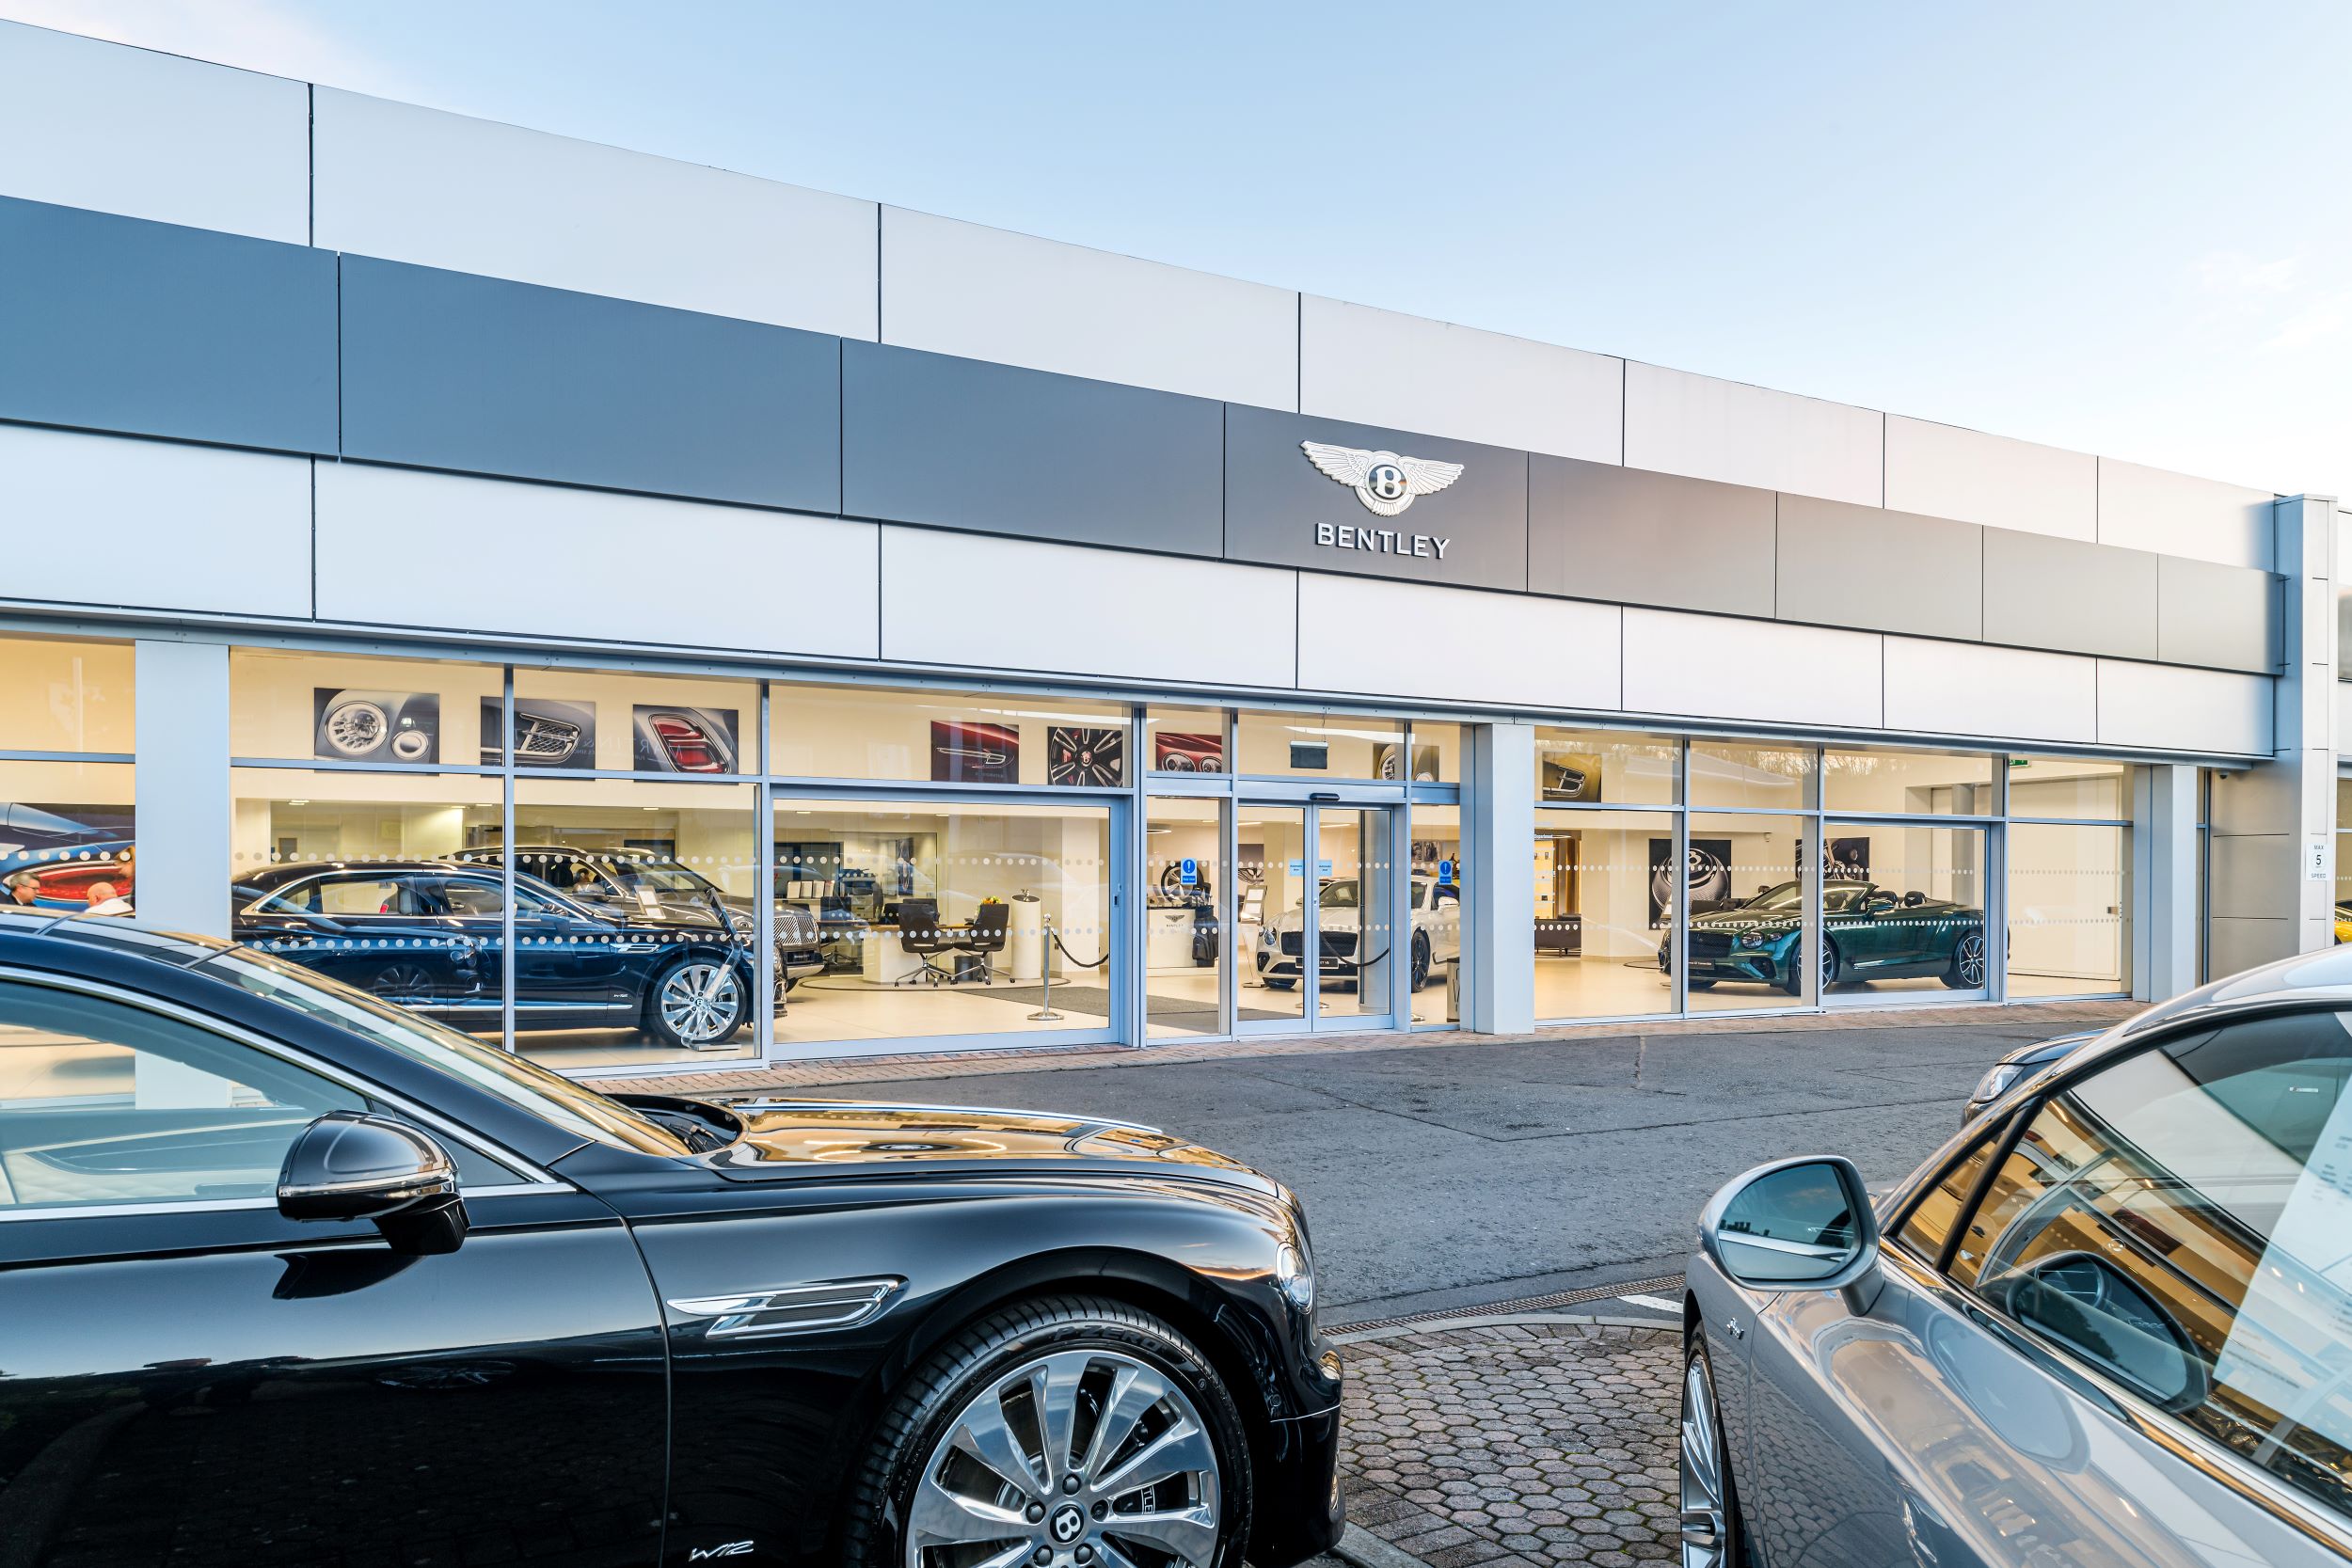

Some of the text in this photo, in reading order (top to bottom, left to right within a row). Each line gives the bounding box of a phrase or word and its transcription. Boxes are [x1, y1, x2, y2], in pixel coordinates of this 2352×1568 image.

[1315, 522, 1451, 560] BENTLEY
[2315, 854, 2322, 864] 5
[1054, 1324, 1163, 1353] P ZERO
[688, 1540, 755, 1562] W12
